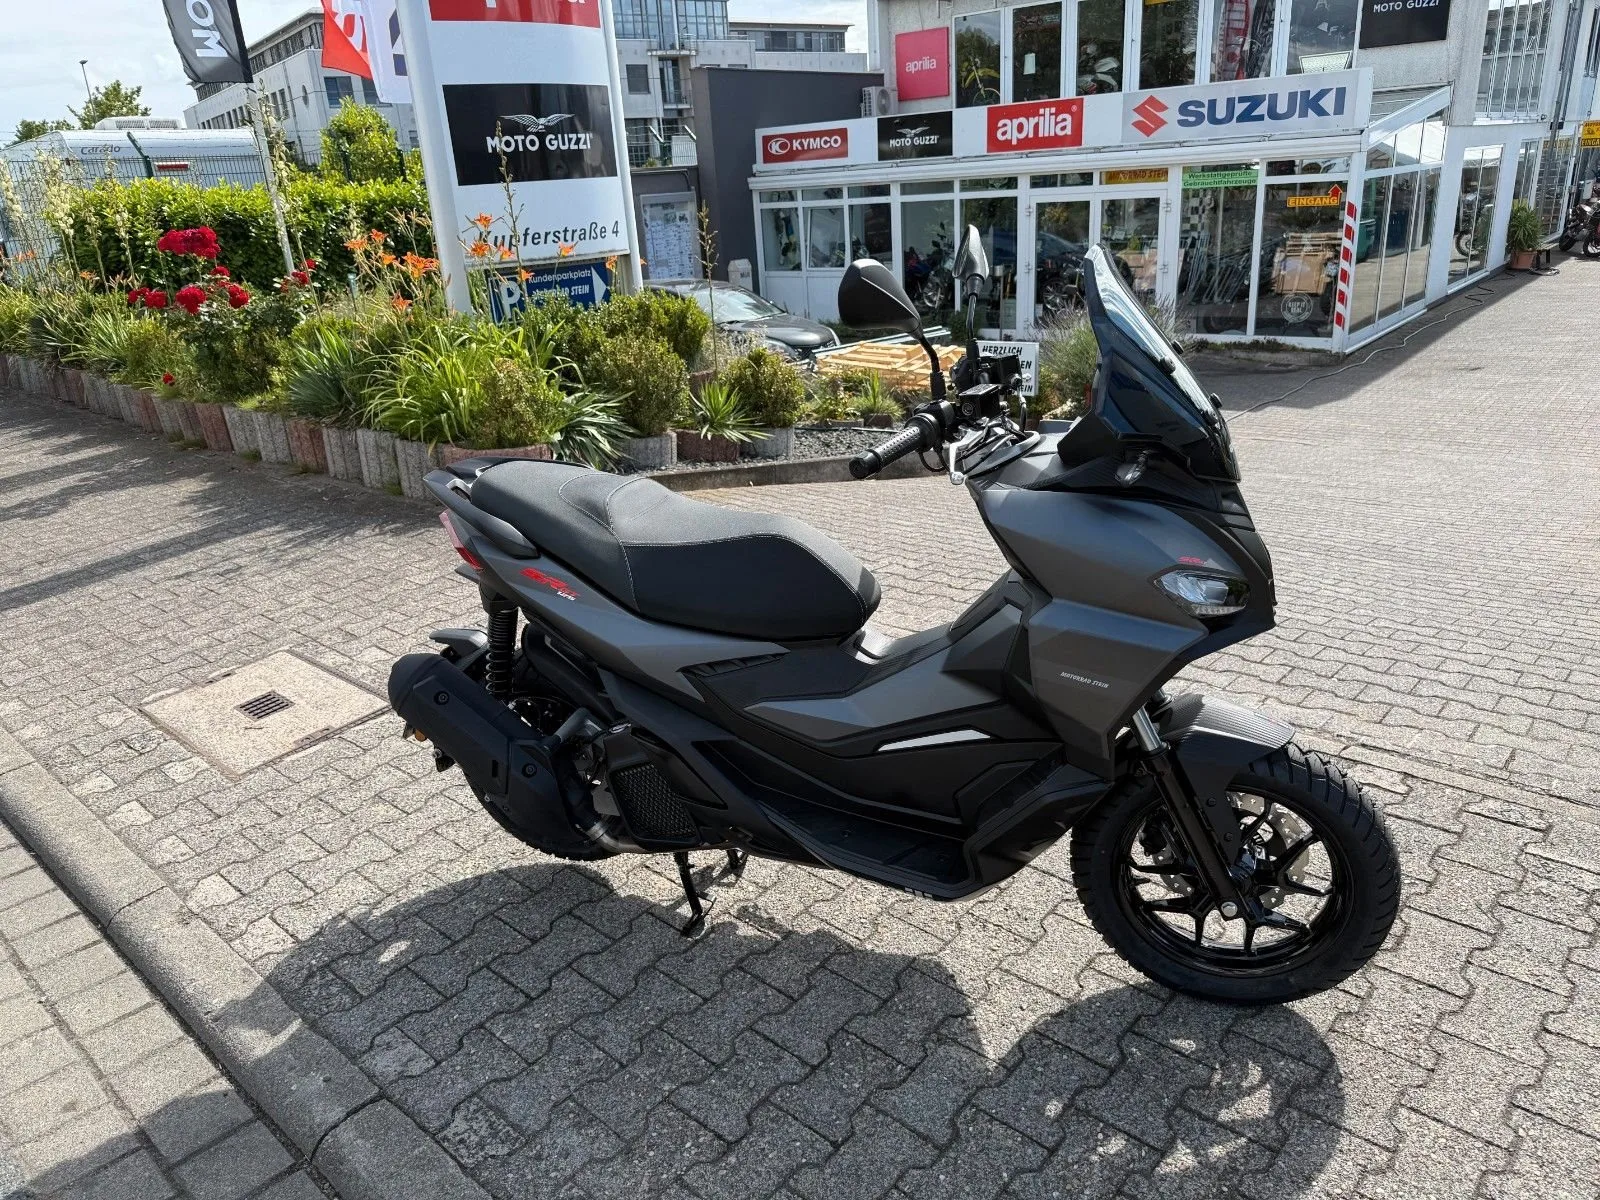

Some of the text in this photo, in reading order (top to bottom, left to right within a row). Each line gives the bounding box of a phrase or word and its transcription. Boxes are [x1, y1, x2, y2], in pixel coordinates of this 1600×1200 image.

[1373, 0, 1439, 13] MOTO GUZZI
[905, 56, 937, 74] aprilia
[1176, 86, 1347, 128] SUZUKI
[996, 107, 1072, 145] aprilia
[485, 132, 592, 154] MOTO GUZZI
[792, 135, 842, 151] KYMCO
[889, 135, 938, 148] MOTO GUZZI
[1288, 196, 1338, 206] EINGANG
[611, 220, 620, 238] 4
[528, 269, 592, 284] Kundenparkplatz
[570, 284, 590, 296] STEIN
[499, 280, 521, 318] P
[982, 345, 1023, 356] HERZLICH
